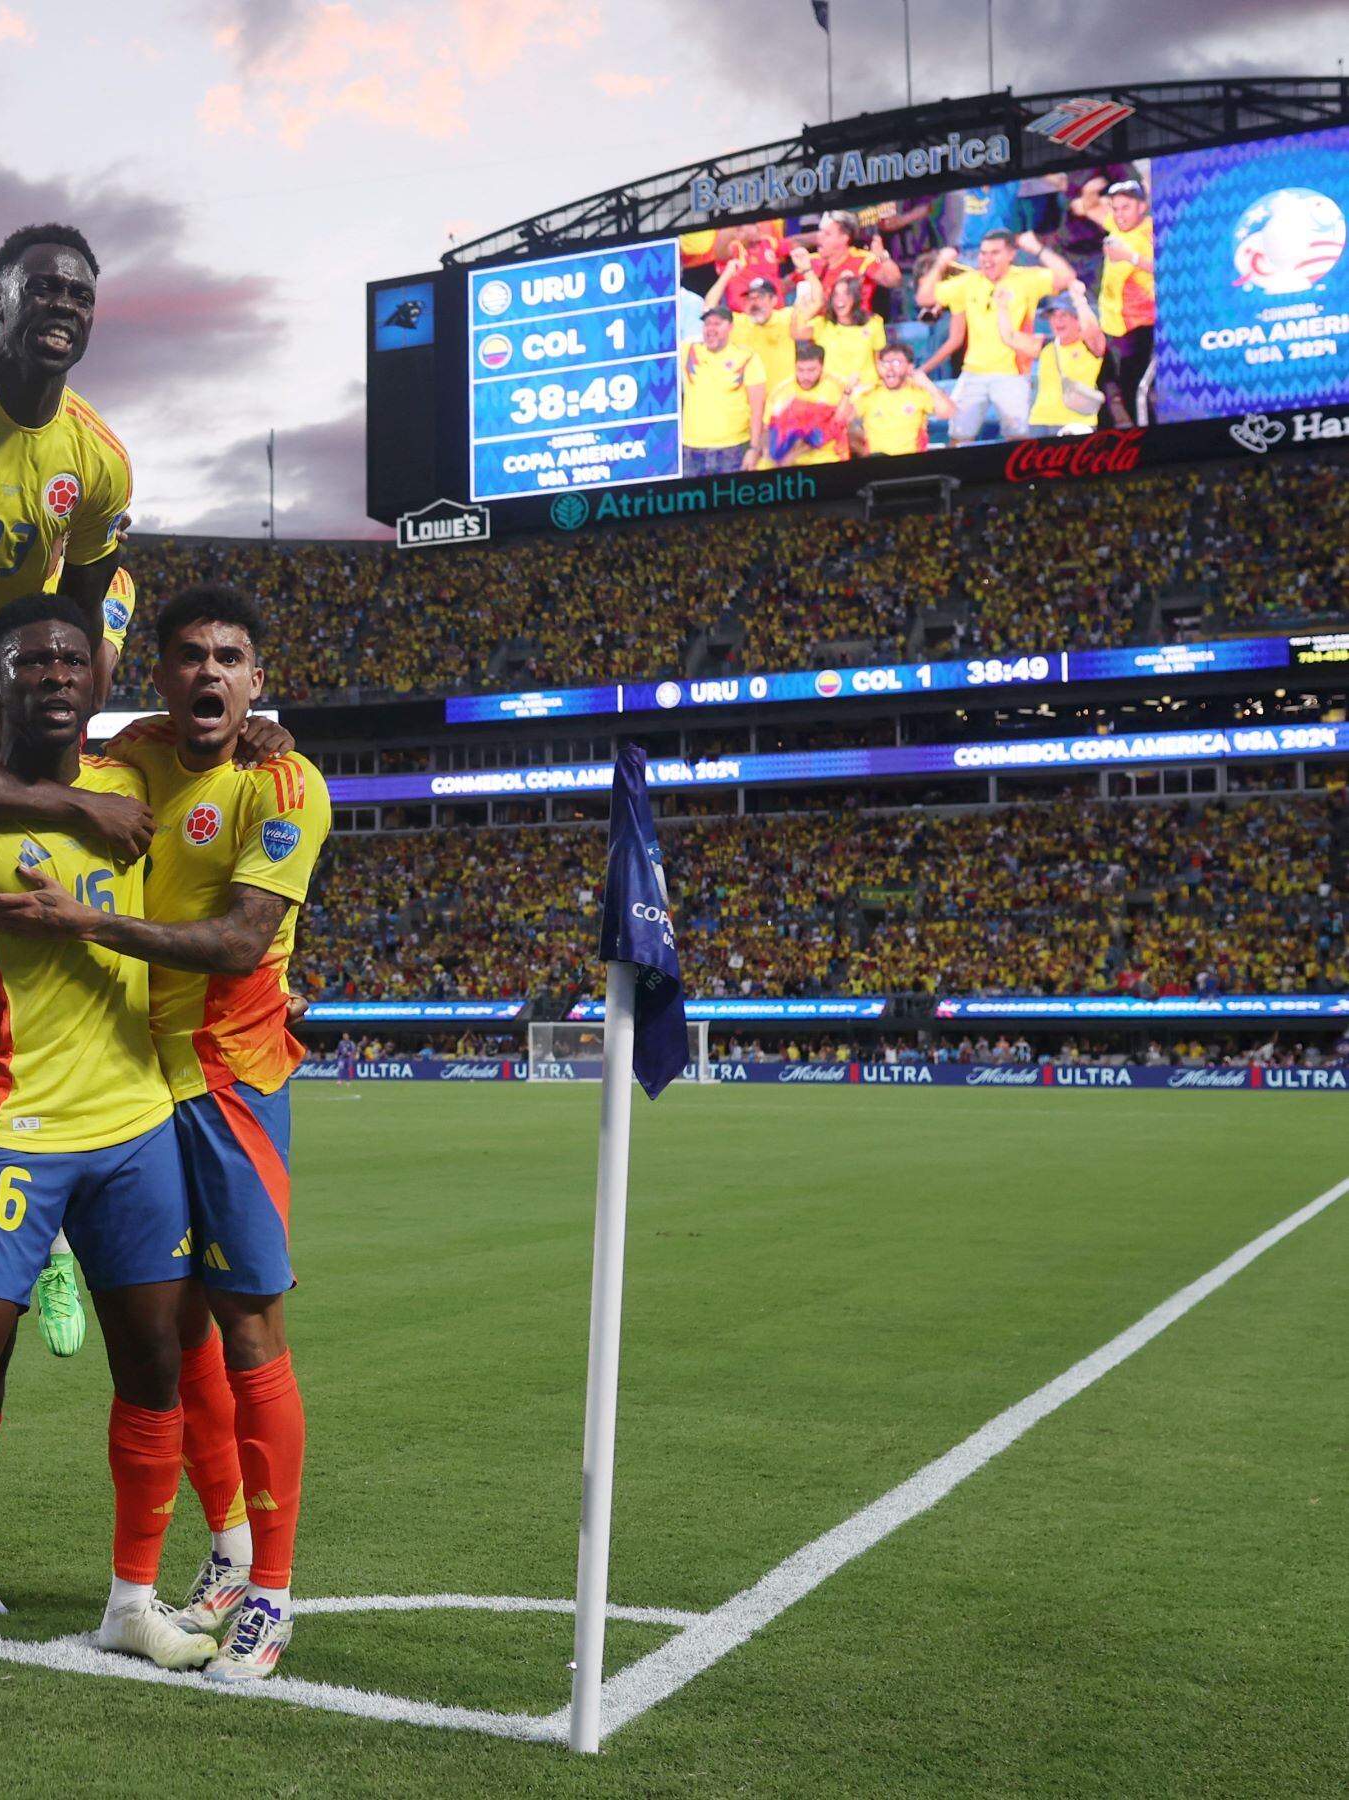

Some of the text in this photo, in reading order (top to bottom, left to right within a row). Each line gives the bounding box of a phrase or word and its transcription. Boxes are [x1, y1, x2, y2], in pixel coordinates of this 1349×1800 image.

[690, 132, 1010, 214] Bank of America
[521, 262, 625, 306] URU 0
[522, 319, 626, 361] COL 1
[1200, 325, 1266, 350] COPA
[1244, 339, 1337, 365] USA 2024
[510, 375, 638, 425] 38:49
[502, 452, 555, 473] COPA
[556, 440, 646, 467] AMERICA
[596, 472, 816, 521] Atrium Health
[406, 513, 481, 543] LOWE'S
[690, 656, 1049, 703] URU 0 COL 1 38:49
[954, 728, 1337, 767] CONMEBOL COPA AMERICA USA 2024
[431, 775, 525, 794] CONMEBOL
[525, 771, 577, 789] COPA
[658, 764, 693, 782] USA
[695, 760, 740, 779] 2024
[265, 829, 295, 841] VIBRA
[966, 1002, 1074, 1013] CONMEBOL
[1075, 1002, 1130, 1012] COPA
[1129, 1001, 1224, 1012] AMERICA
[291, 1063, 339, 1078] Michelo
[356, 1063, 413, 1078] ULTRA
[440, 1062, 499, 1079] Michelob
[682, 1063, 1347, 1088] UTRA Michelob ULTRA Michelob ULTRA Michelob ULTRA
